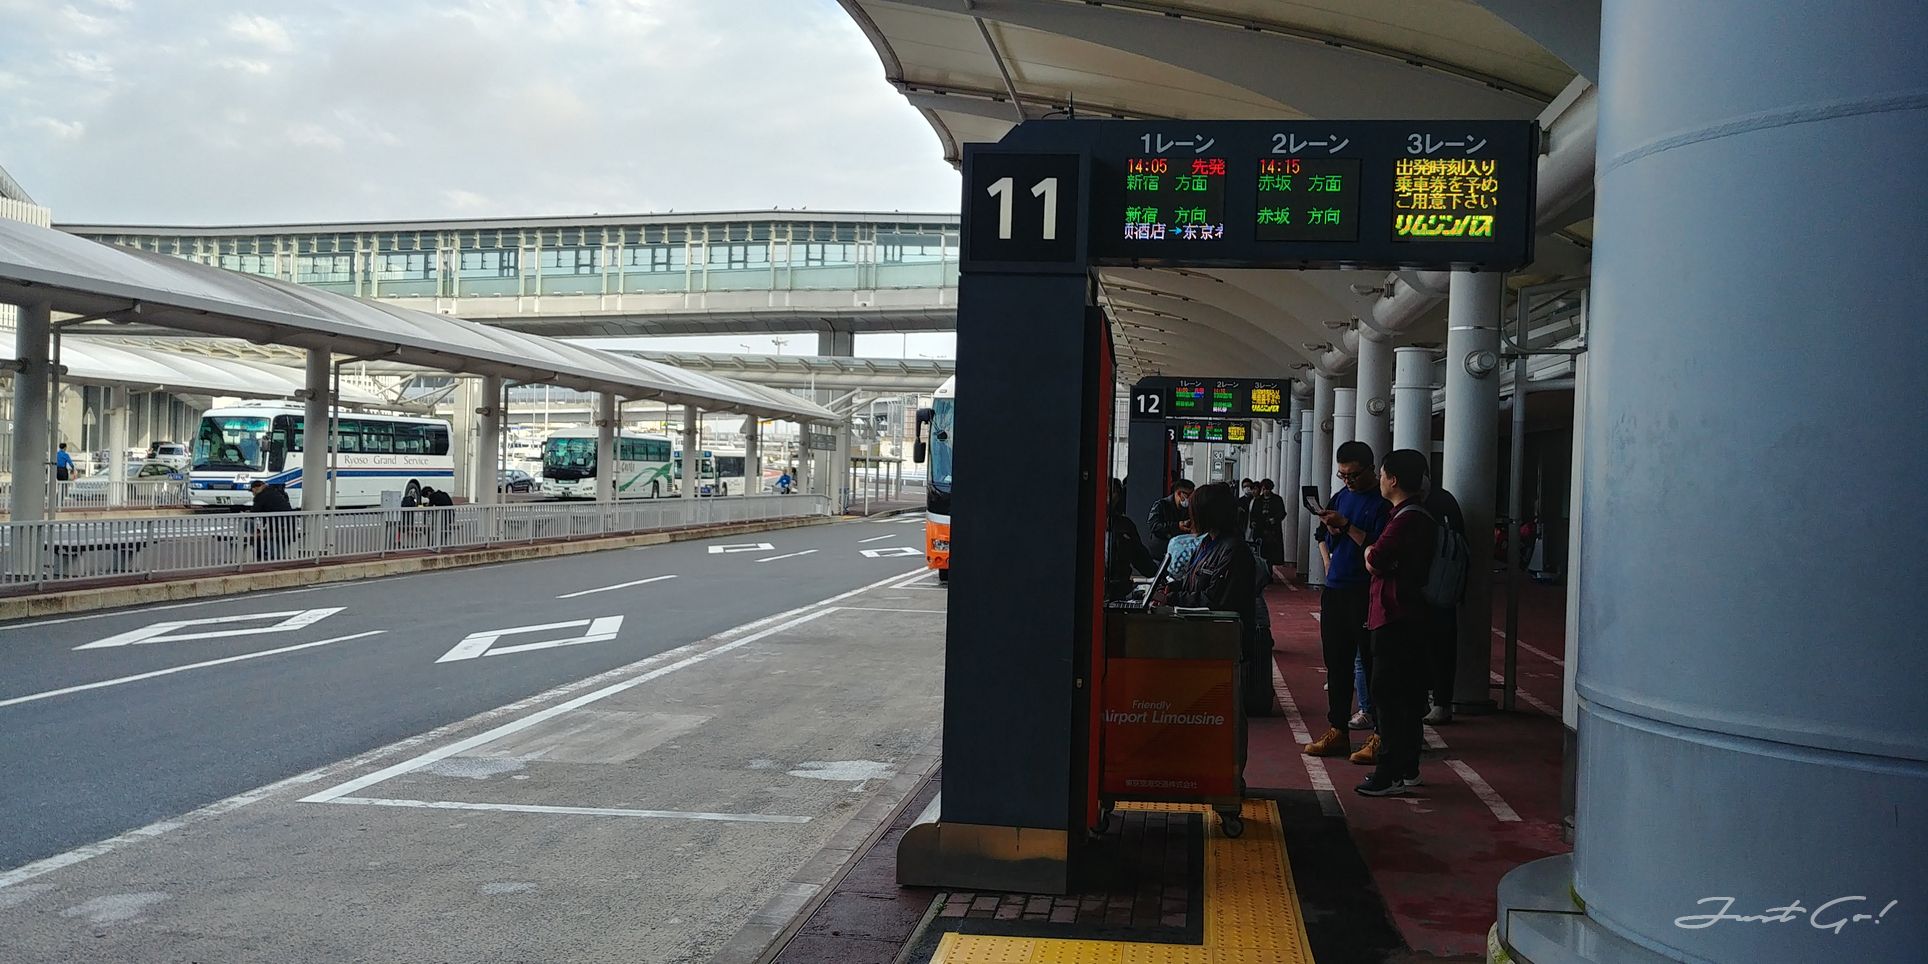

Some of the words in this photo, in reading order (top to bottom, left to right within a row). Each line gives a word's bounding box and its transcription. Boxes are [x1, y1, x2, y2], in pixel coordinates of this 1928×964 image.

[1140, 133, 1215, 154] 1レーン
[1271, 133, 1350, 154] 2レーン
[1406, 133, 1487, 154] 3レーン
[1129, 159, 1168, 173] 14:05
[1191, 158, 1225, 175] 先発
[1260, 159, 1301, 174] 14:15
[1396, 158, 1495, 176] 出発時刻入り
[1126, 174, 1160, 191] 新宿
[1175, 174, 1208, 191] 方面
[1258, 174, 1292, 192] 赤坂
[1308, 174, 1342, 192] 方面
[1394, 176, 1498, 193] 乗車券を予め
[987, 177, 1057, 240] 11
[1396, 192, 1498, 210] ご用意下さい
[1125, 206, 1159, 223] 新宿
[1174, 206, 1207, 224] 方向
[1257, 206, 1291, 225] 赤坂
[1307, 206, 1341, 225] 方向
[1394, 214, 1494, 237] リムジンバス
[1137, 394, 1160, 413] 12
[344, 454, 368, 467] Ryoso
[373, 455, 397, 465] Grand
[403, 456, 429, 465] Service
[1132, 699, 1171, 710] Friendly
[1151, 710, 1225, 726] Limousine
